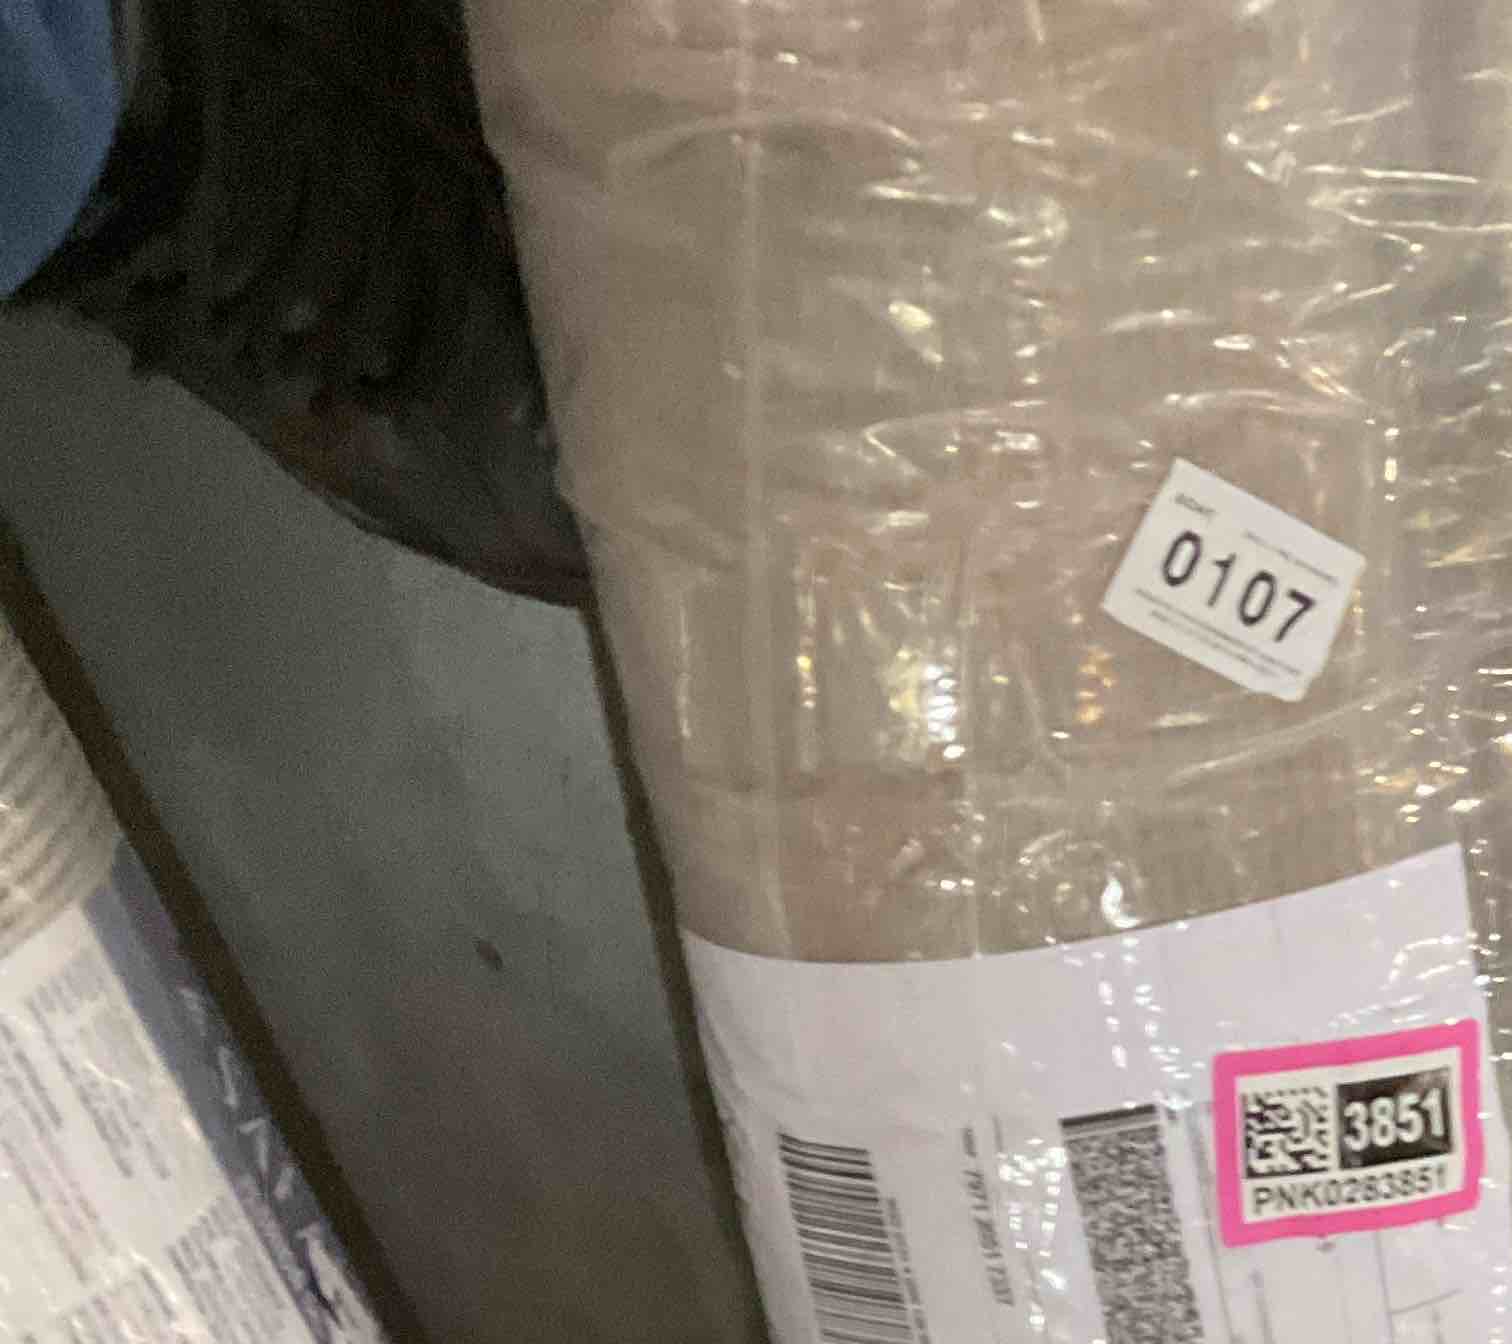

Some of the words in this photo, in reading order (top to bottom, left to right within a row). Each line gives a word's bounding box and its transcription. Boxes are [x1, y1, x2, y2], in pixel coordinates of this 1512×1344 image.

[1162, 530, 1317, 643] 0107
[1343, 1087, 1446, 1152] 3851
[1252, 1162, 1447, 1214] PNK0283851
